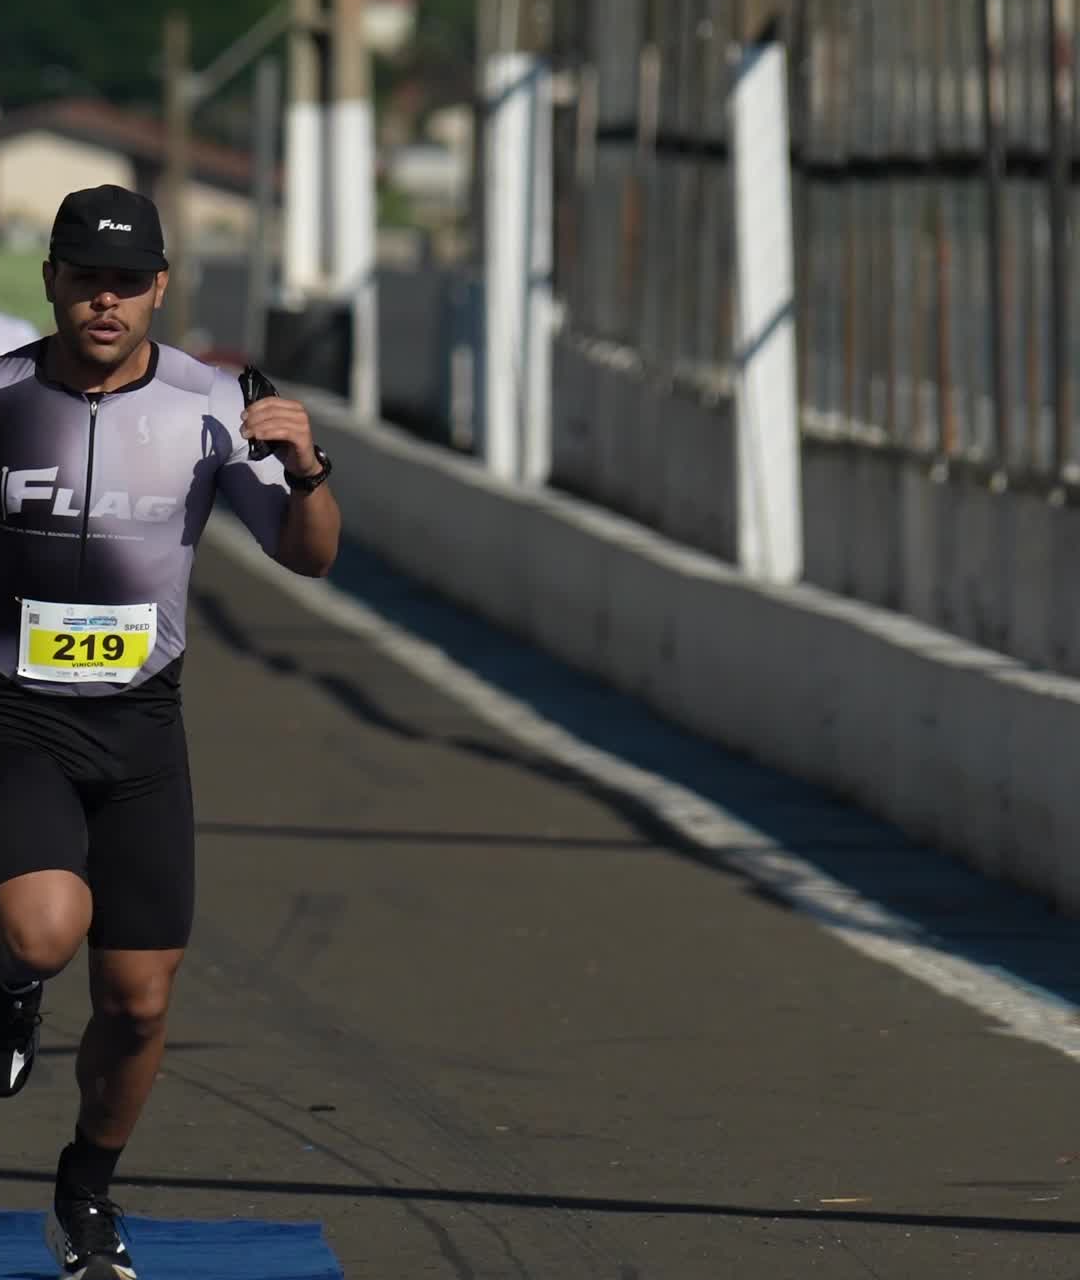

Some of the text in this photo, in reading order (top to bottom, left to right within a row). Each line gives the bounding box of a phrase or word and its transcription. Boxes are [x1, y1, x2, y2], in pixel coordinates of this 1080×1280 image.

[98, 219, 132, 232] FLAG
[5, 466, 177, 521] FLAG
[125, 623, 150, 631] SPEED
[53, 633, 124, 660] 219
